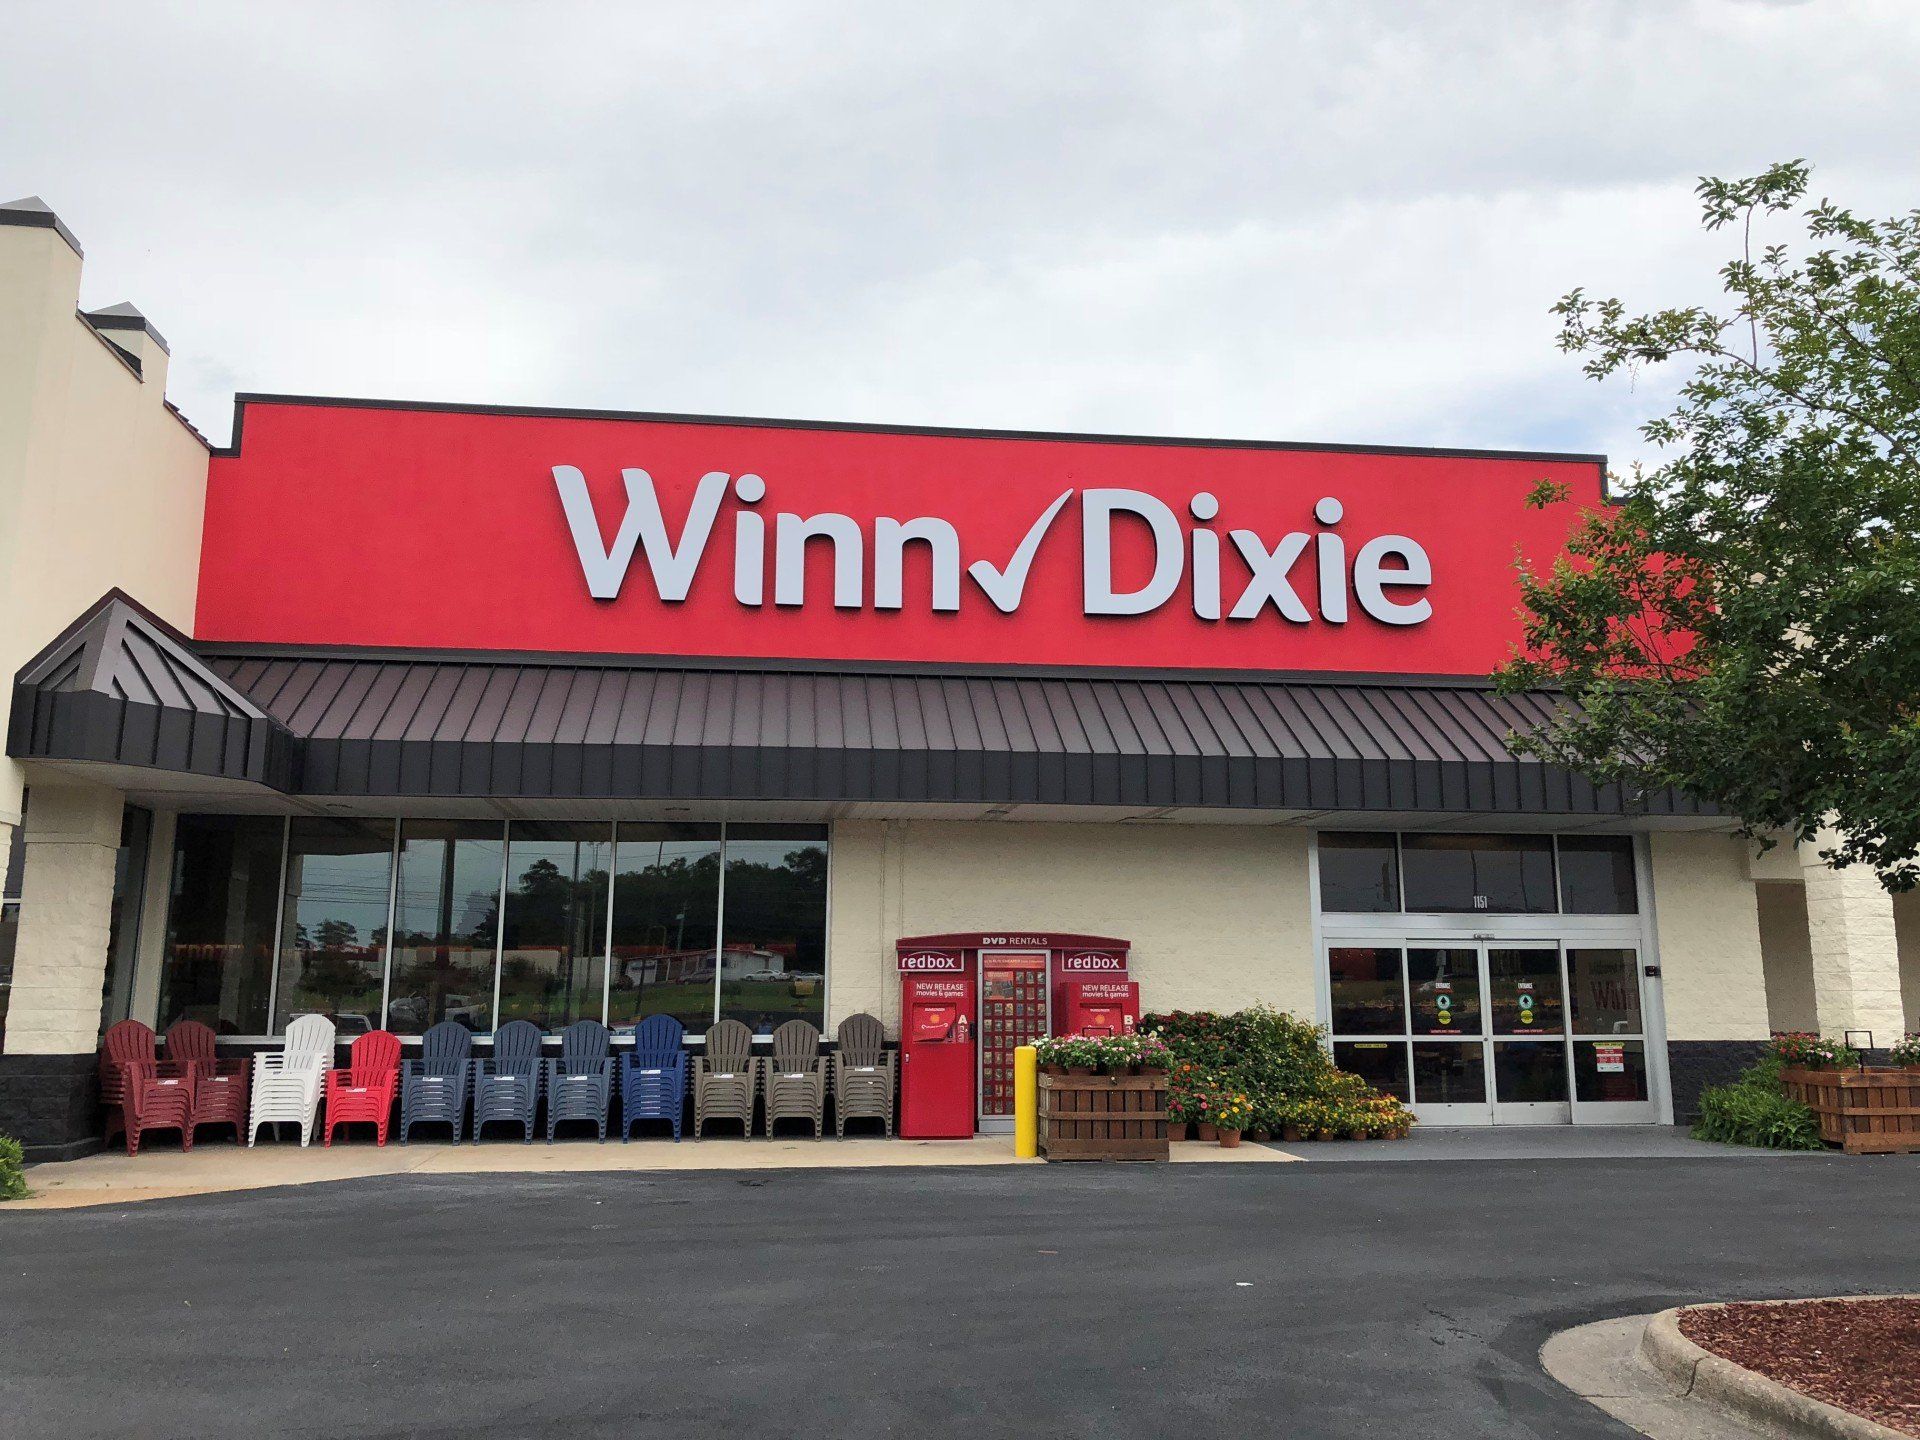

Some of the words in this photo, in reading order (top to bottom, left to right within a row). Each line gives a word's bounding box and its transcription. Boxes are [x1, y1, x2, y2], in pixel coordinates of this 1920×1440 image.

[551, 464, 961, 613] Winn
[1082, 488, 1433, 625] Dixie
[1473, 895, 1488, 909] 1151
[982, 937, 1007, 945] DVD
[1009, 937, 1048, 945] RENTALS
[901, 955, 955, 969] redbox
[1067, 955, 1120, 969] redbox
[934, 983, 964, 991] RELEASE
[1100, 984, 1129, 992] RELEASE
[944, 991, 964, 999] games
[957, 1014, 968, 1025] A
[1123, 1014, 1134, 1026] B
